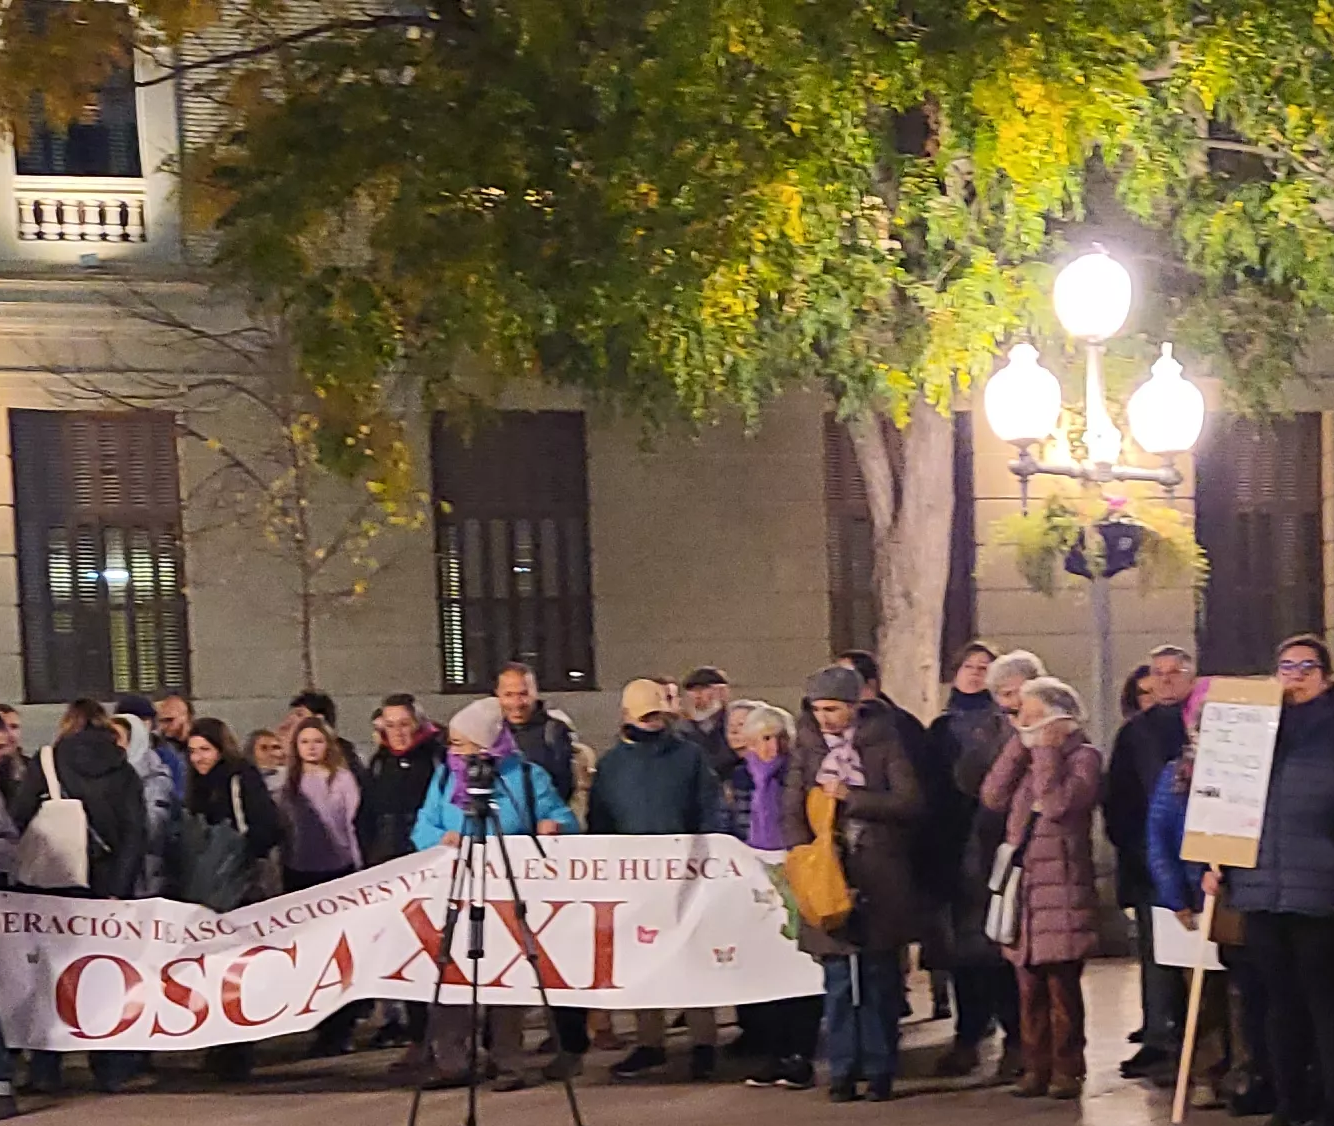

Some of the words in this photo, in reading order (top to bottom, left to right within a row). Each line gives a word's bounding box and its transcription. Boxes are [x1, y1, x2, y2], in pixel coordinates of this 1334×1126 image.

[569, 859, 607, 881] DE
[619, 858, 743, 881] HUESCA
[56, 930, 354, 1040] OSCA
[379, 897, 629, 991] XXI
